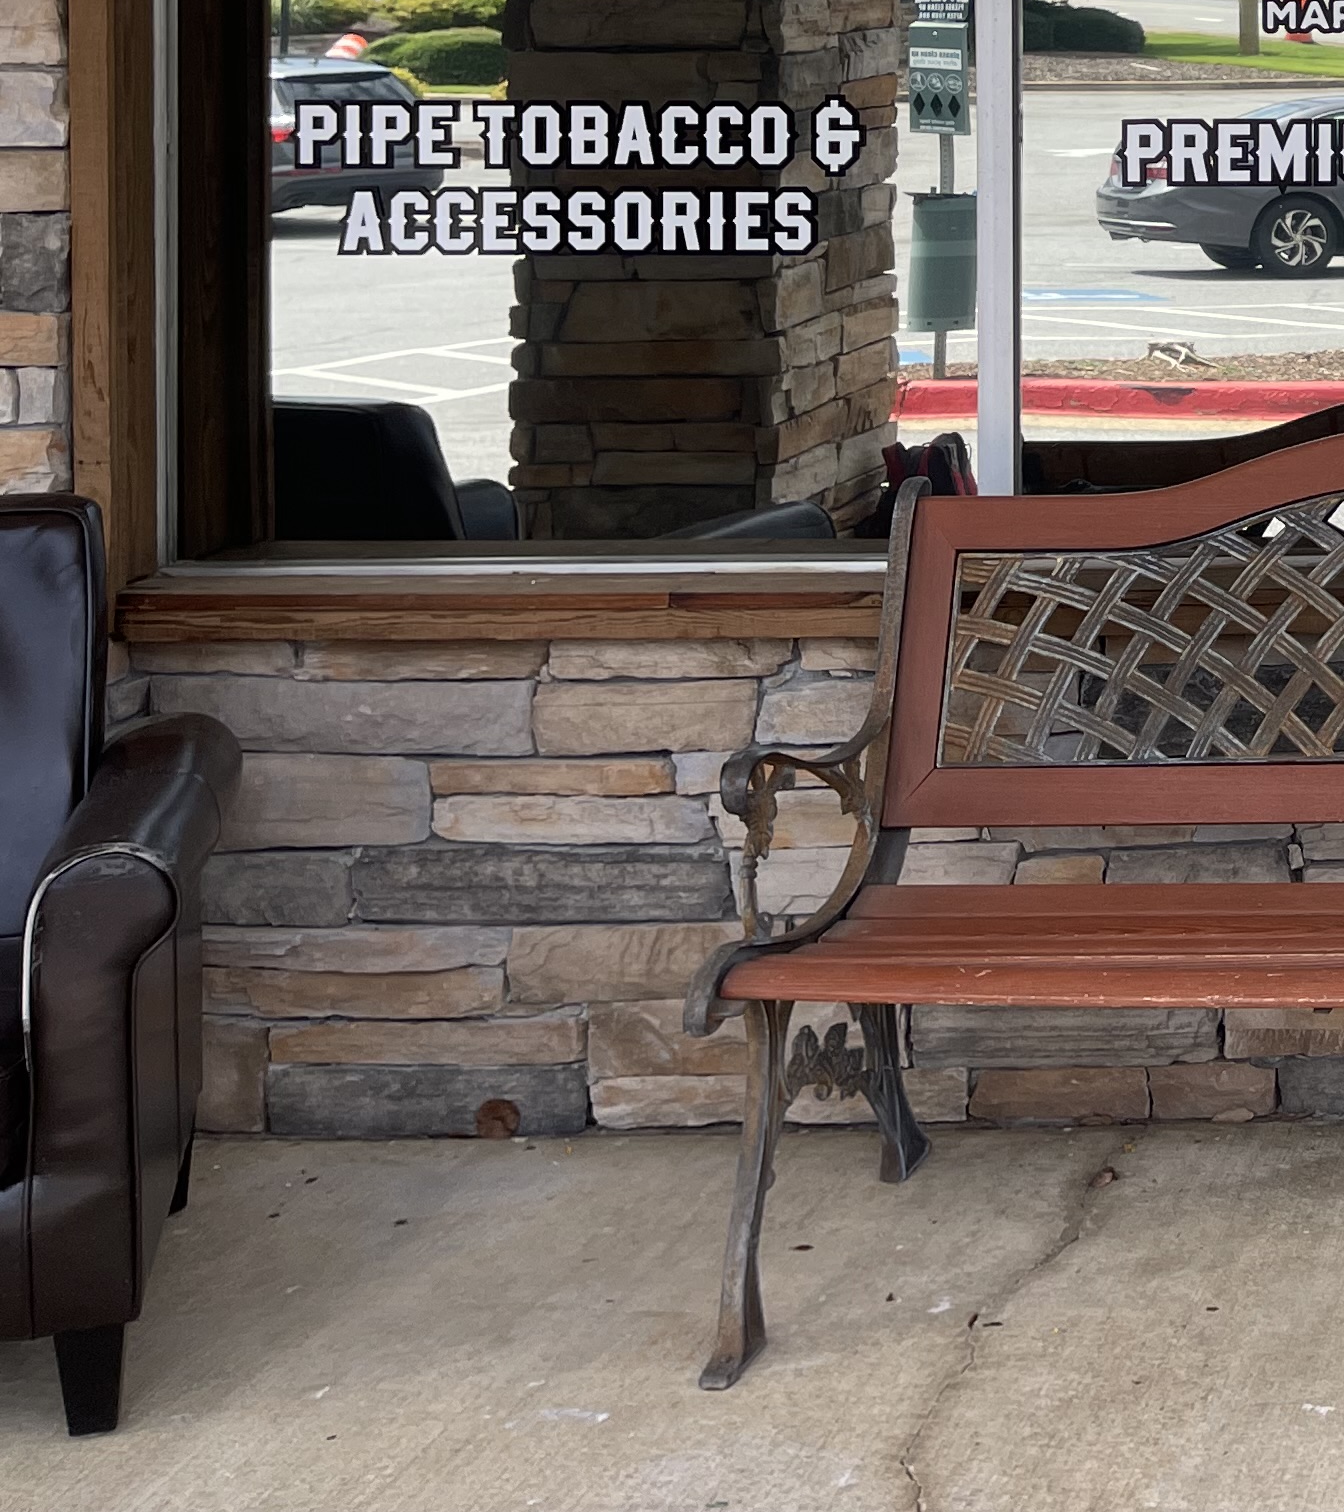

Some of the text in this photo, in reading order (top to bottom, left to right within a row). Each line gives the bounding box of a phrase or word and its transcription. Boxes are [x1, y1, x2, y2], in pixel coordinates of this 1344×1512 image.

[294, 93, 863, 176] PIPE TOBACCO &
[339, 187, 819, 255] ACCESSORIES
